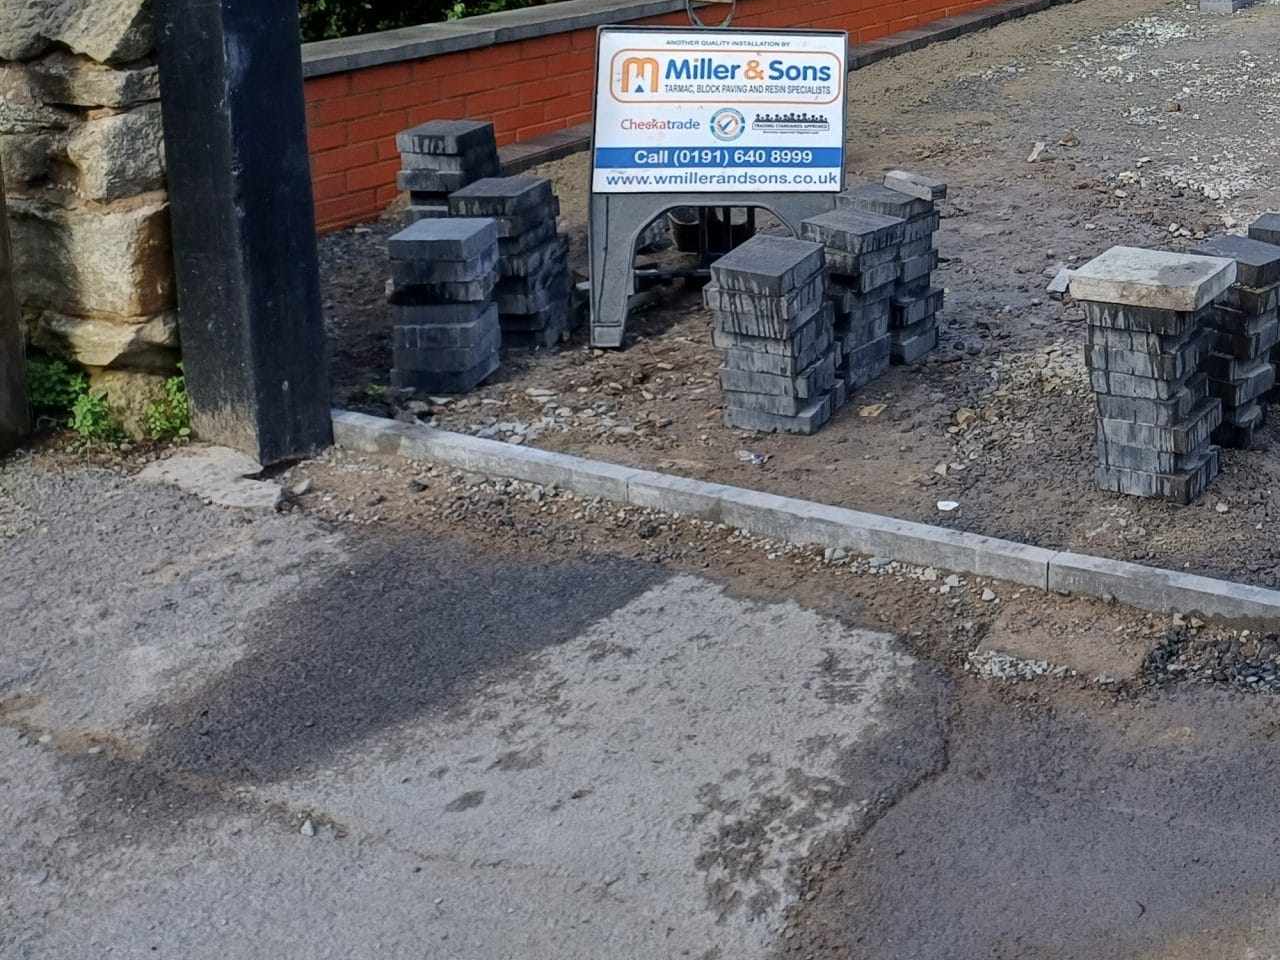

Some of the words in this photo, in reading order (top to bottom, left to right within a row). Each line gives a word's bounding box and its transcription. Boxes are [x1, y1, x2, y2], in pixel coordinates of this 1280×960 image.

[665, 57, 741, 80] Miller
[744, 60, 764, 80] &
[768, 60, 831, 82] Sons
[665, 84, 695, 95] TARMAC,
[697, 84, 720, 94] BLOCK
[722, 84, 747, 95] PAVING
[748, 84, 763, 95] AND
[765, 85, 785, 95] RESIN
[787, 85, 831, 95] SPECIALISTS
[621, 118, 700, 130] Checkatrade
[634, 149, 668, 164] Call
[673, 149, 729, 167] (0191)
[734, 149, 765, 164] 640
[770, 150, 813, 164] 8999
[605, 171, 838, 186] www.wmillerandsons.co.uk
